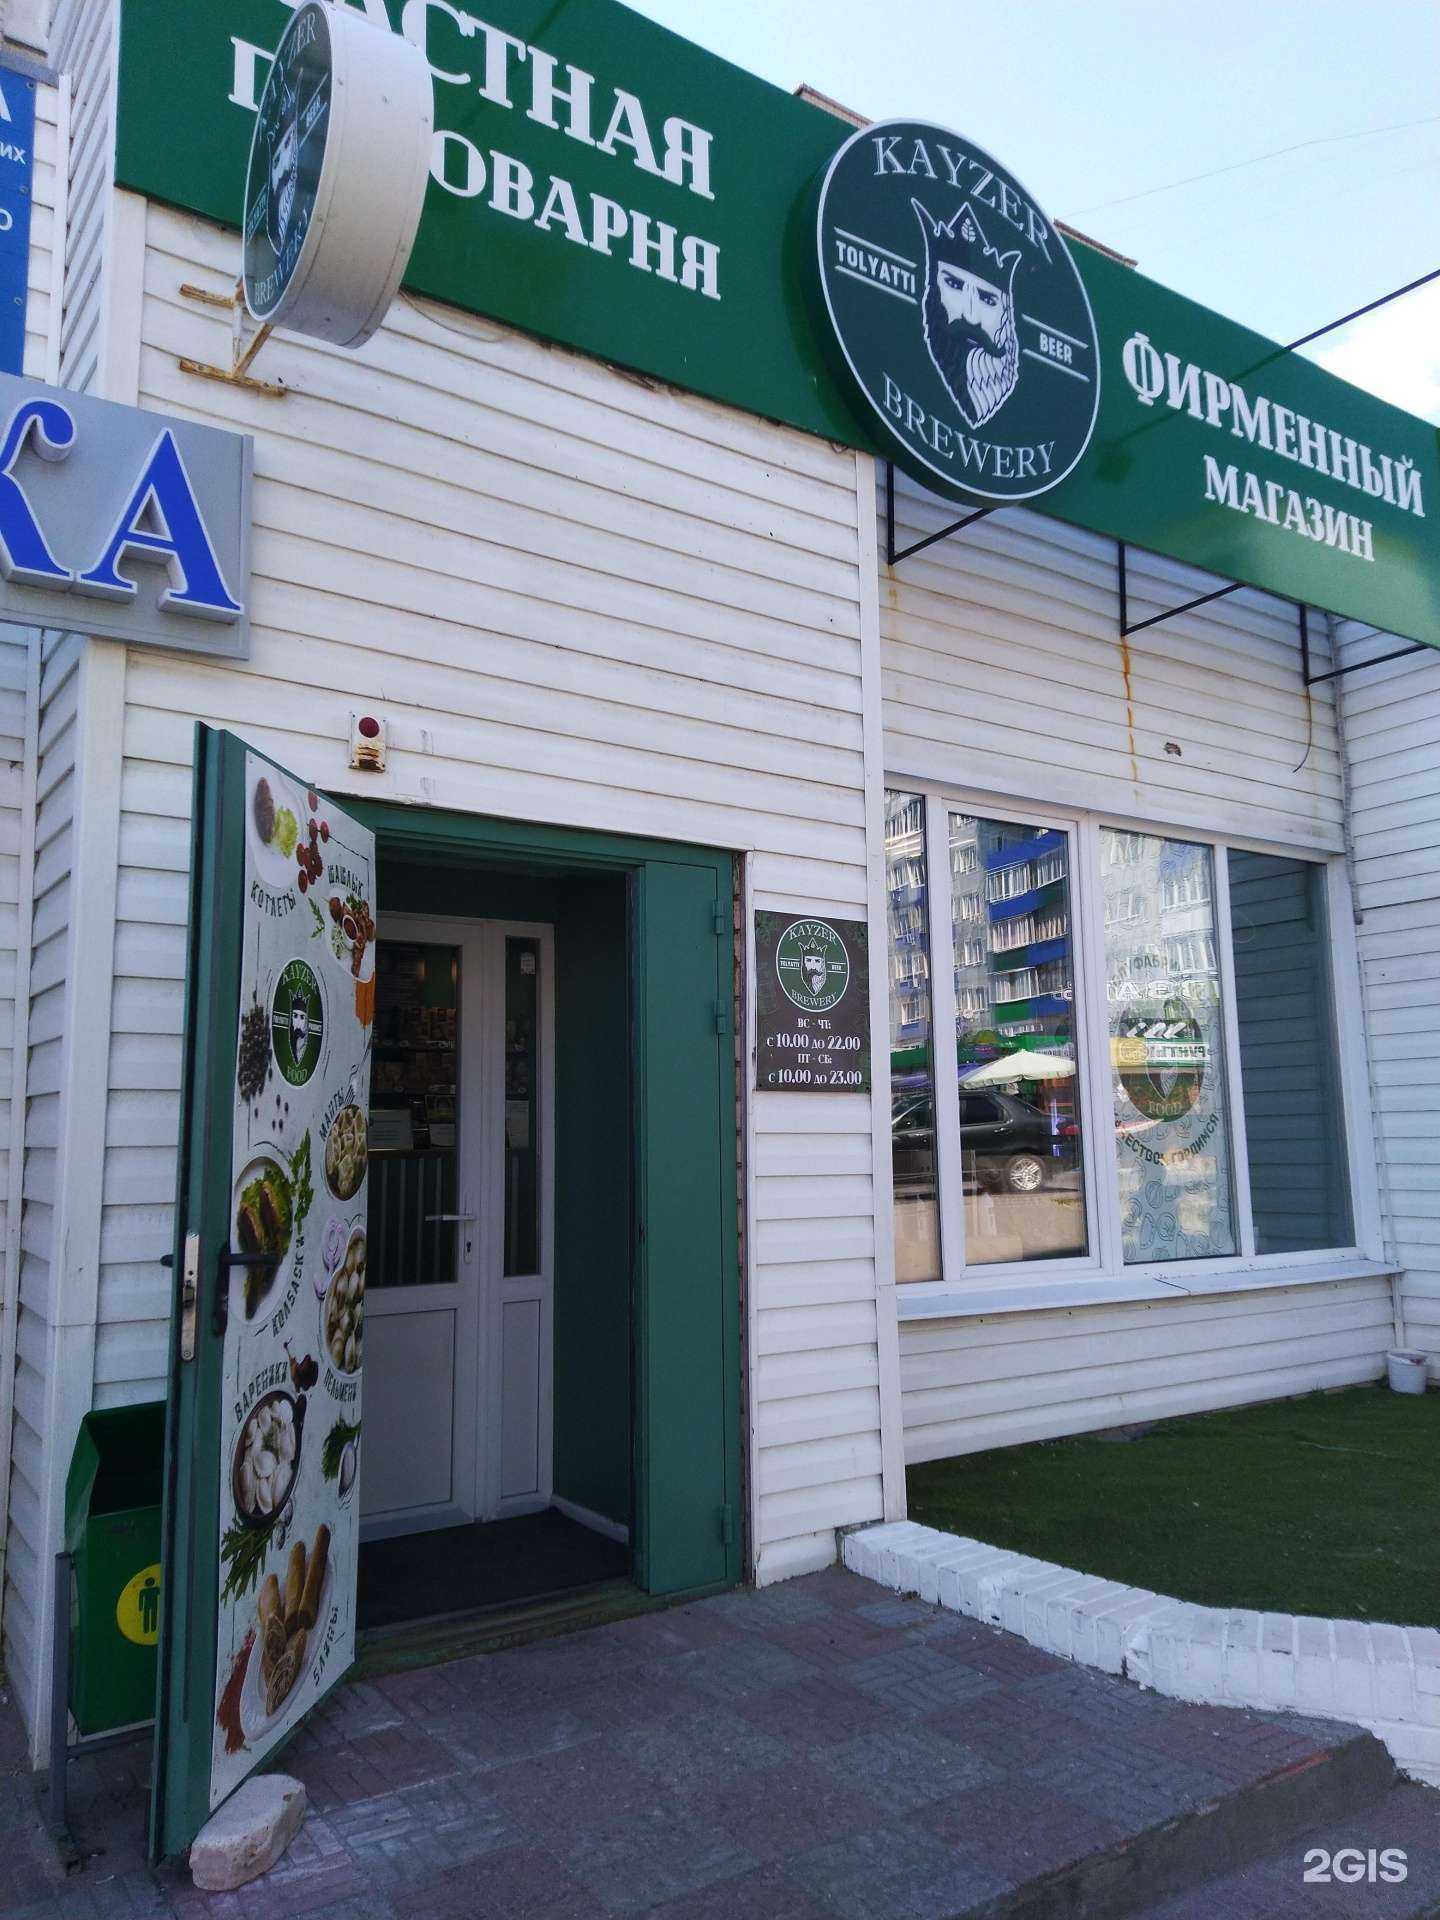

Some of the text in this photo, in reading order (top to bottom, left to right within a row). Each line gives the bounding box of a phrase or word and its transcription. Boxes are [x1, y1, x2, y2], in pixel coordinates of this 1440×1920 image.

[872, 136, 1053, 264] KAYZER
[835, 239, 916, 294] TOLYATTI
[1038, 332, 1073, 365] BEER
[882, 372, 1056, 480] BREWERY
[1122, 331, 1425, 517] ФИРМЕННЫЙ
[1203, 454, 1375, 562] МАГАЗИН
[250, 880, 297, 918] КОТЛЕТЫ
[327, 864, 363, 898] ШАШЛЫК
[788, 924, 838, 946] KAYZER
[790, 988, 837, 1007] BREWERY
[776, 1032, 809, 1048] 10.00
[811, 1040, 825, 1050] до
[827, 1035, 861, 1050] 22.00
[796, 1018, 810, 1028] ВС
[818, 1019, 831, 1030] ЧТ:
[778, 1069, 811, 1084] 10.00
[813, 1074, 827, 1085] до
[829, 1070, 863, 1085] 23.00
[797, 1053, 811, 1064] ПТ
[818, 1054, 833, 1064] СБ:
[319, 1086, 346, 1142] МАНТЫ
[271, 1235, 305, 1338] КОЛБАСКИ
[234, 1360, 289, 1423] ВАРЕНИКИ
[323, 1367, 357, 1403] ПЕЛЬМЕНИ
[312, 1606, 339, 1687] БЛИНЫ
